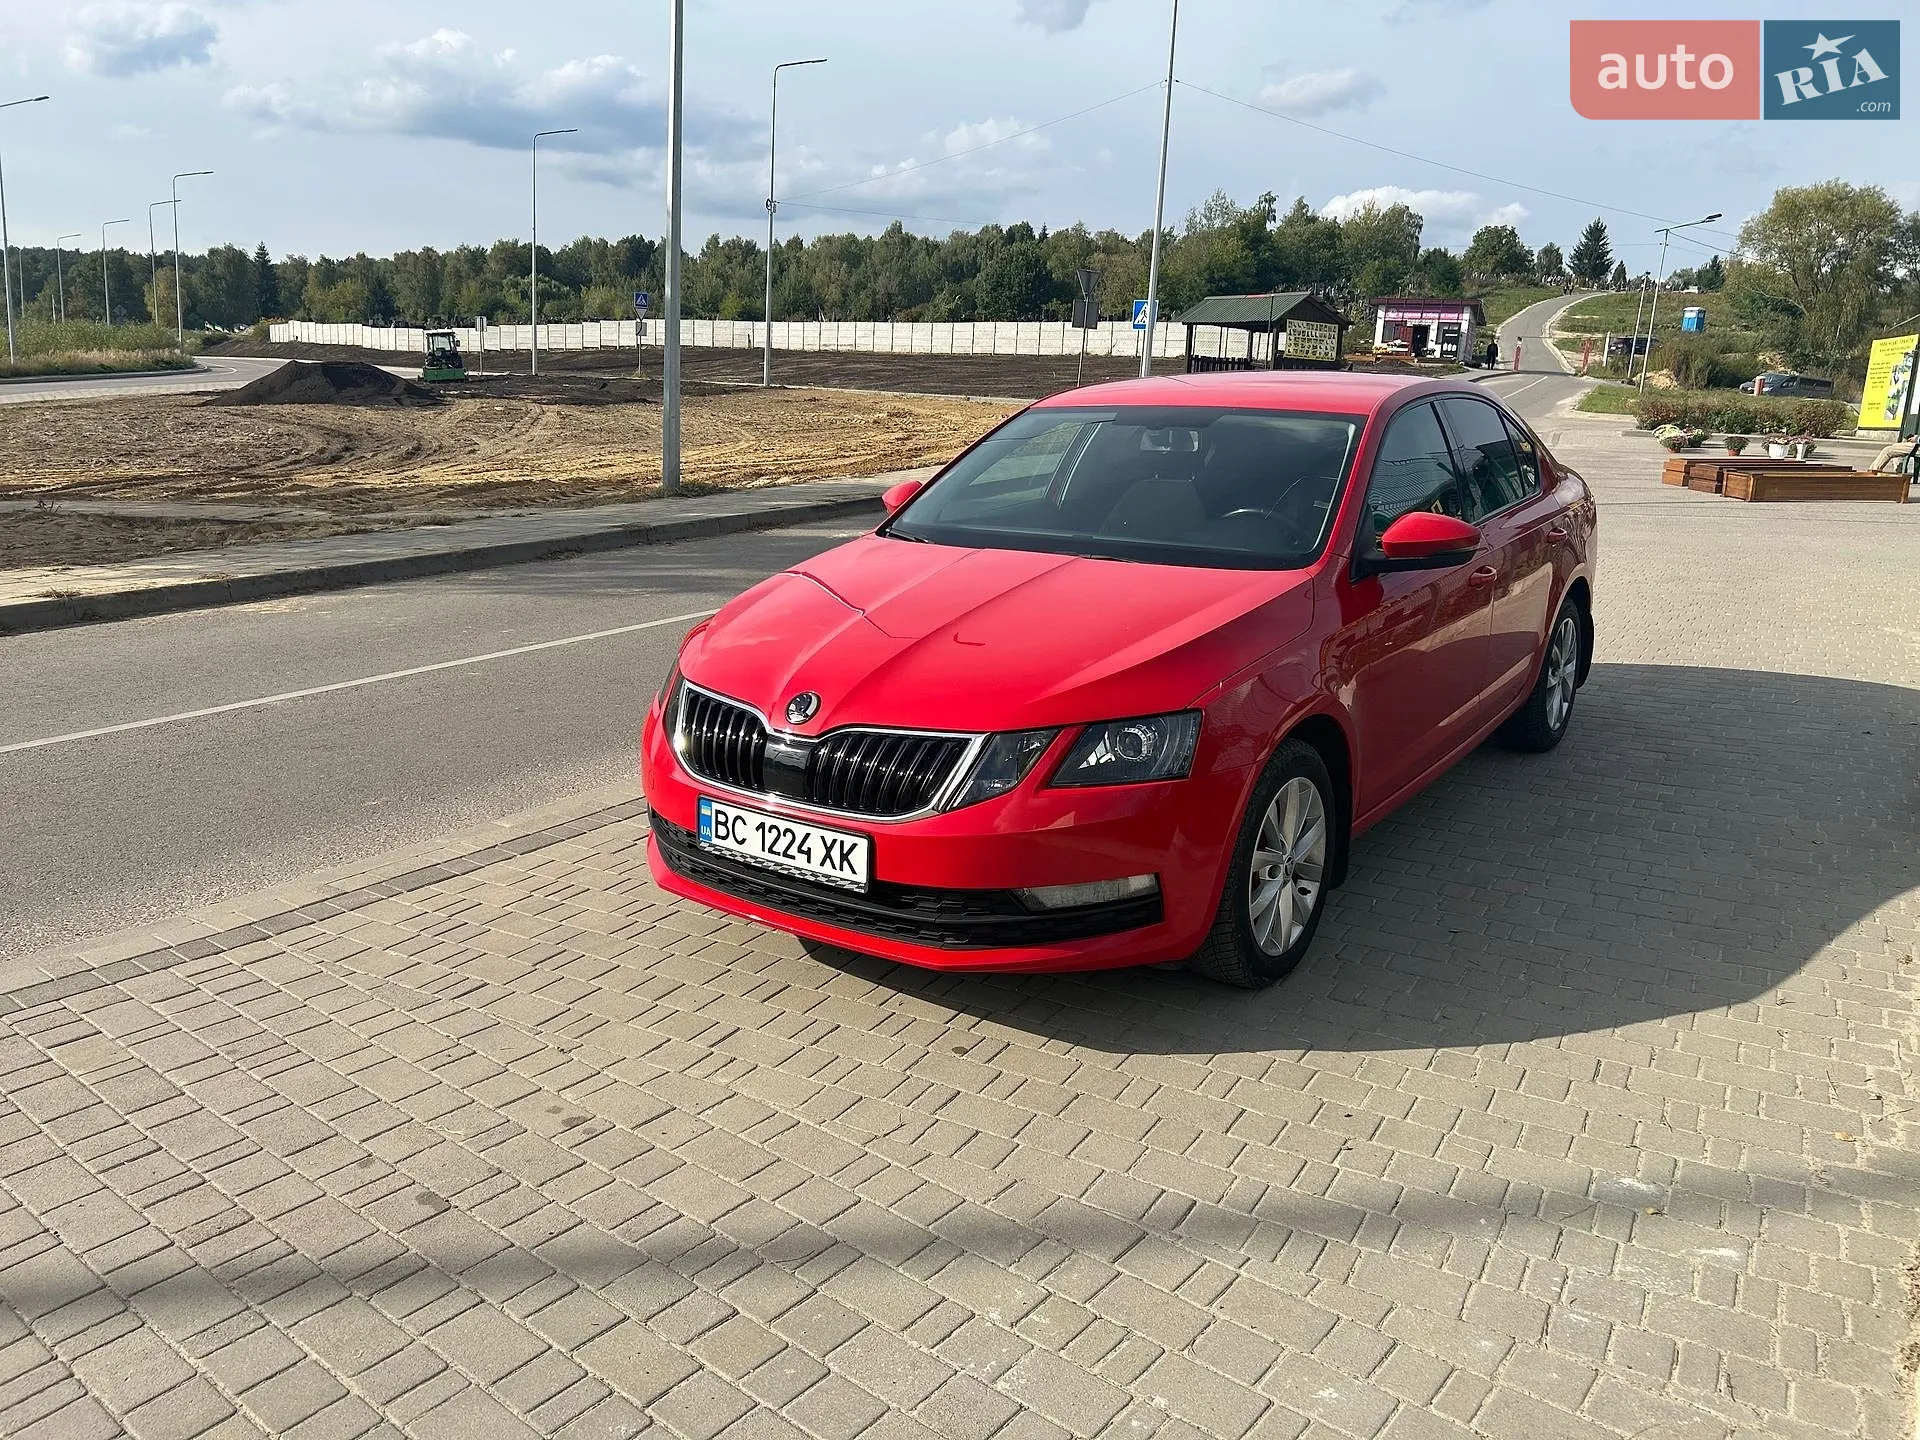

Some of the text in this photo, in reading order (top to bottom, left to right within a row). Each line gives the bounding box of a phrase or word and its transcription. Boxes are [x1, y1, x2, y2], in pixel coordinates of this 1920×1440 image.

[701, 826, 711, 837] UA
[715, 808, 858, 875] BC 1224 XK
